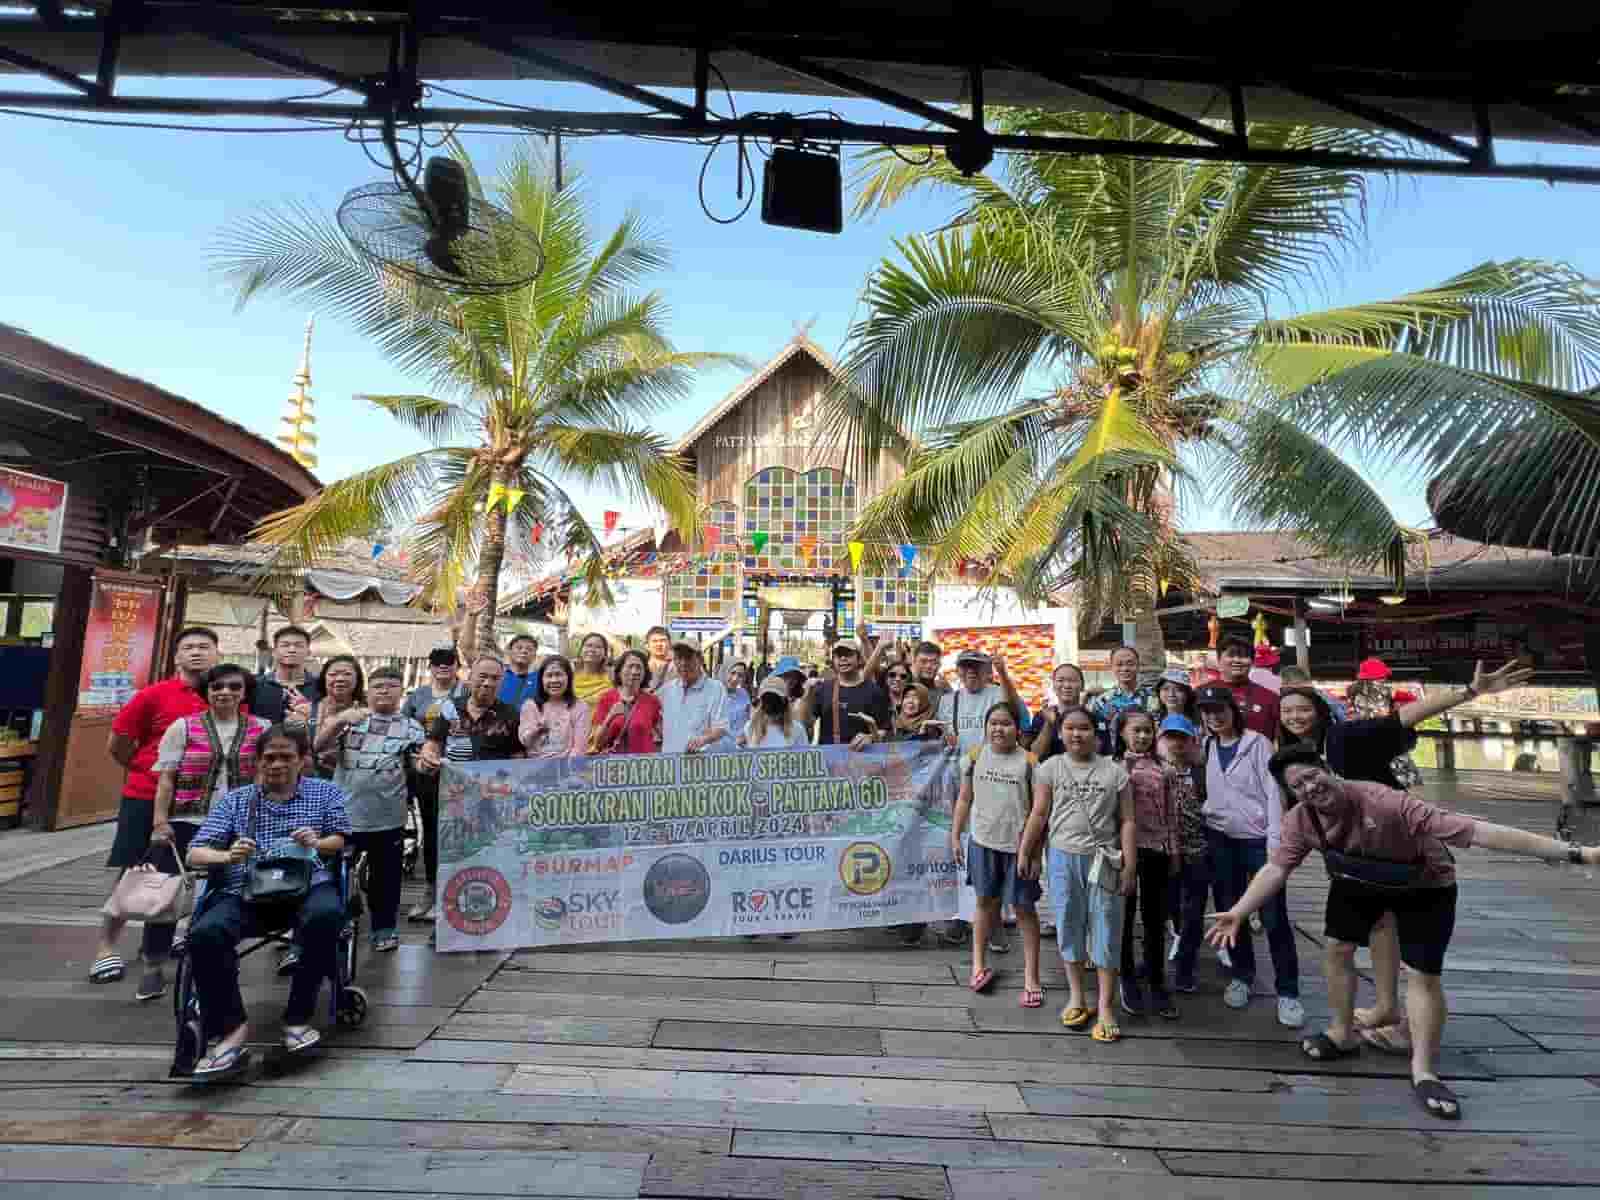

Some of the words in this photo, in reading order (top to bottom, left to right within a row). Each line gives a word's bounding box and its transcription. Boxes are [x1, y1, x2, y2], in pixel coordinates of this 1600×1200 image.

[594, 758, 675, 787] LEBARAN
[679, 753, 754, 785] HOLIDAY
[757, 749, 826, 781] SPECIAL
[529, 789, 649, 826] SONGKRAN
[653, 782, 753, 819] BANGKOK
[769, 777, 854, 814] PATTAYA
[623, 825, 642, 841] 12
[693, 816, 753, 838] APRIL
[758, 814, 808, 835] 2024
[719, 848, 777, 866] DARIUS
[784, 845, 825, 863] TOUR
[569, 889, 619, 914] SKY
[731, 887, 814, 913] ROYCE
